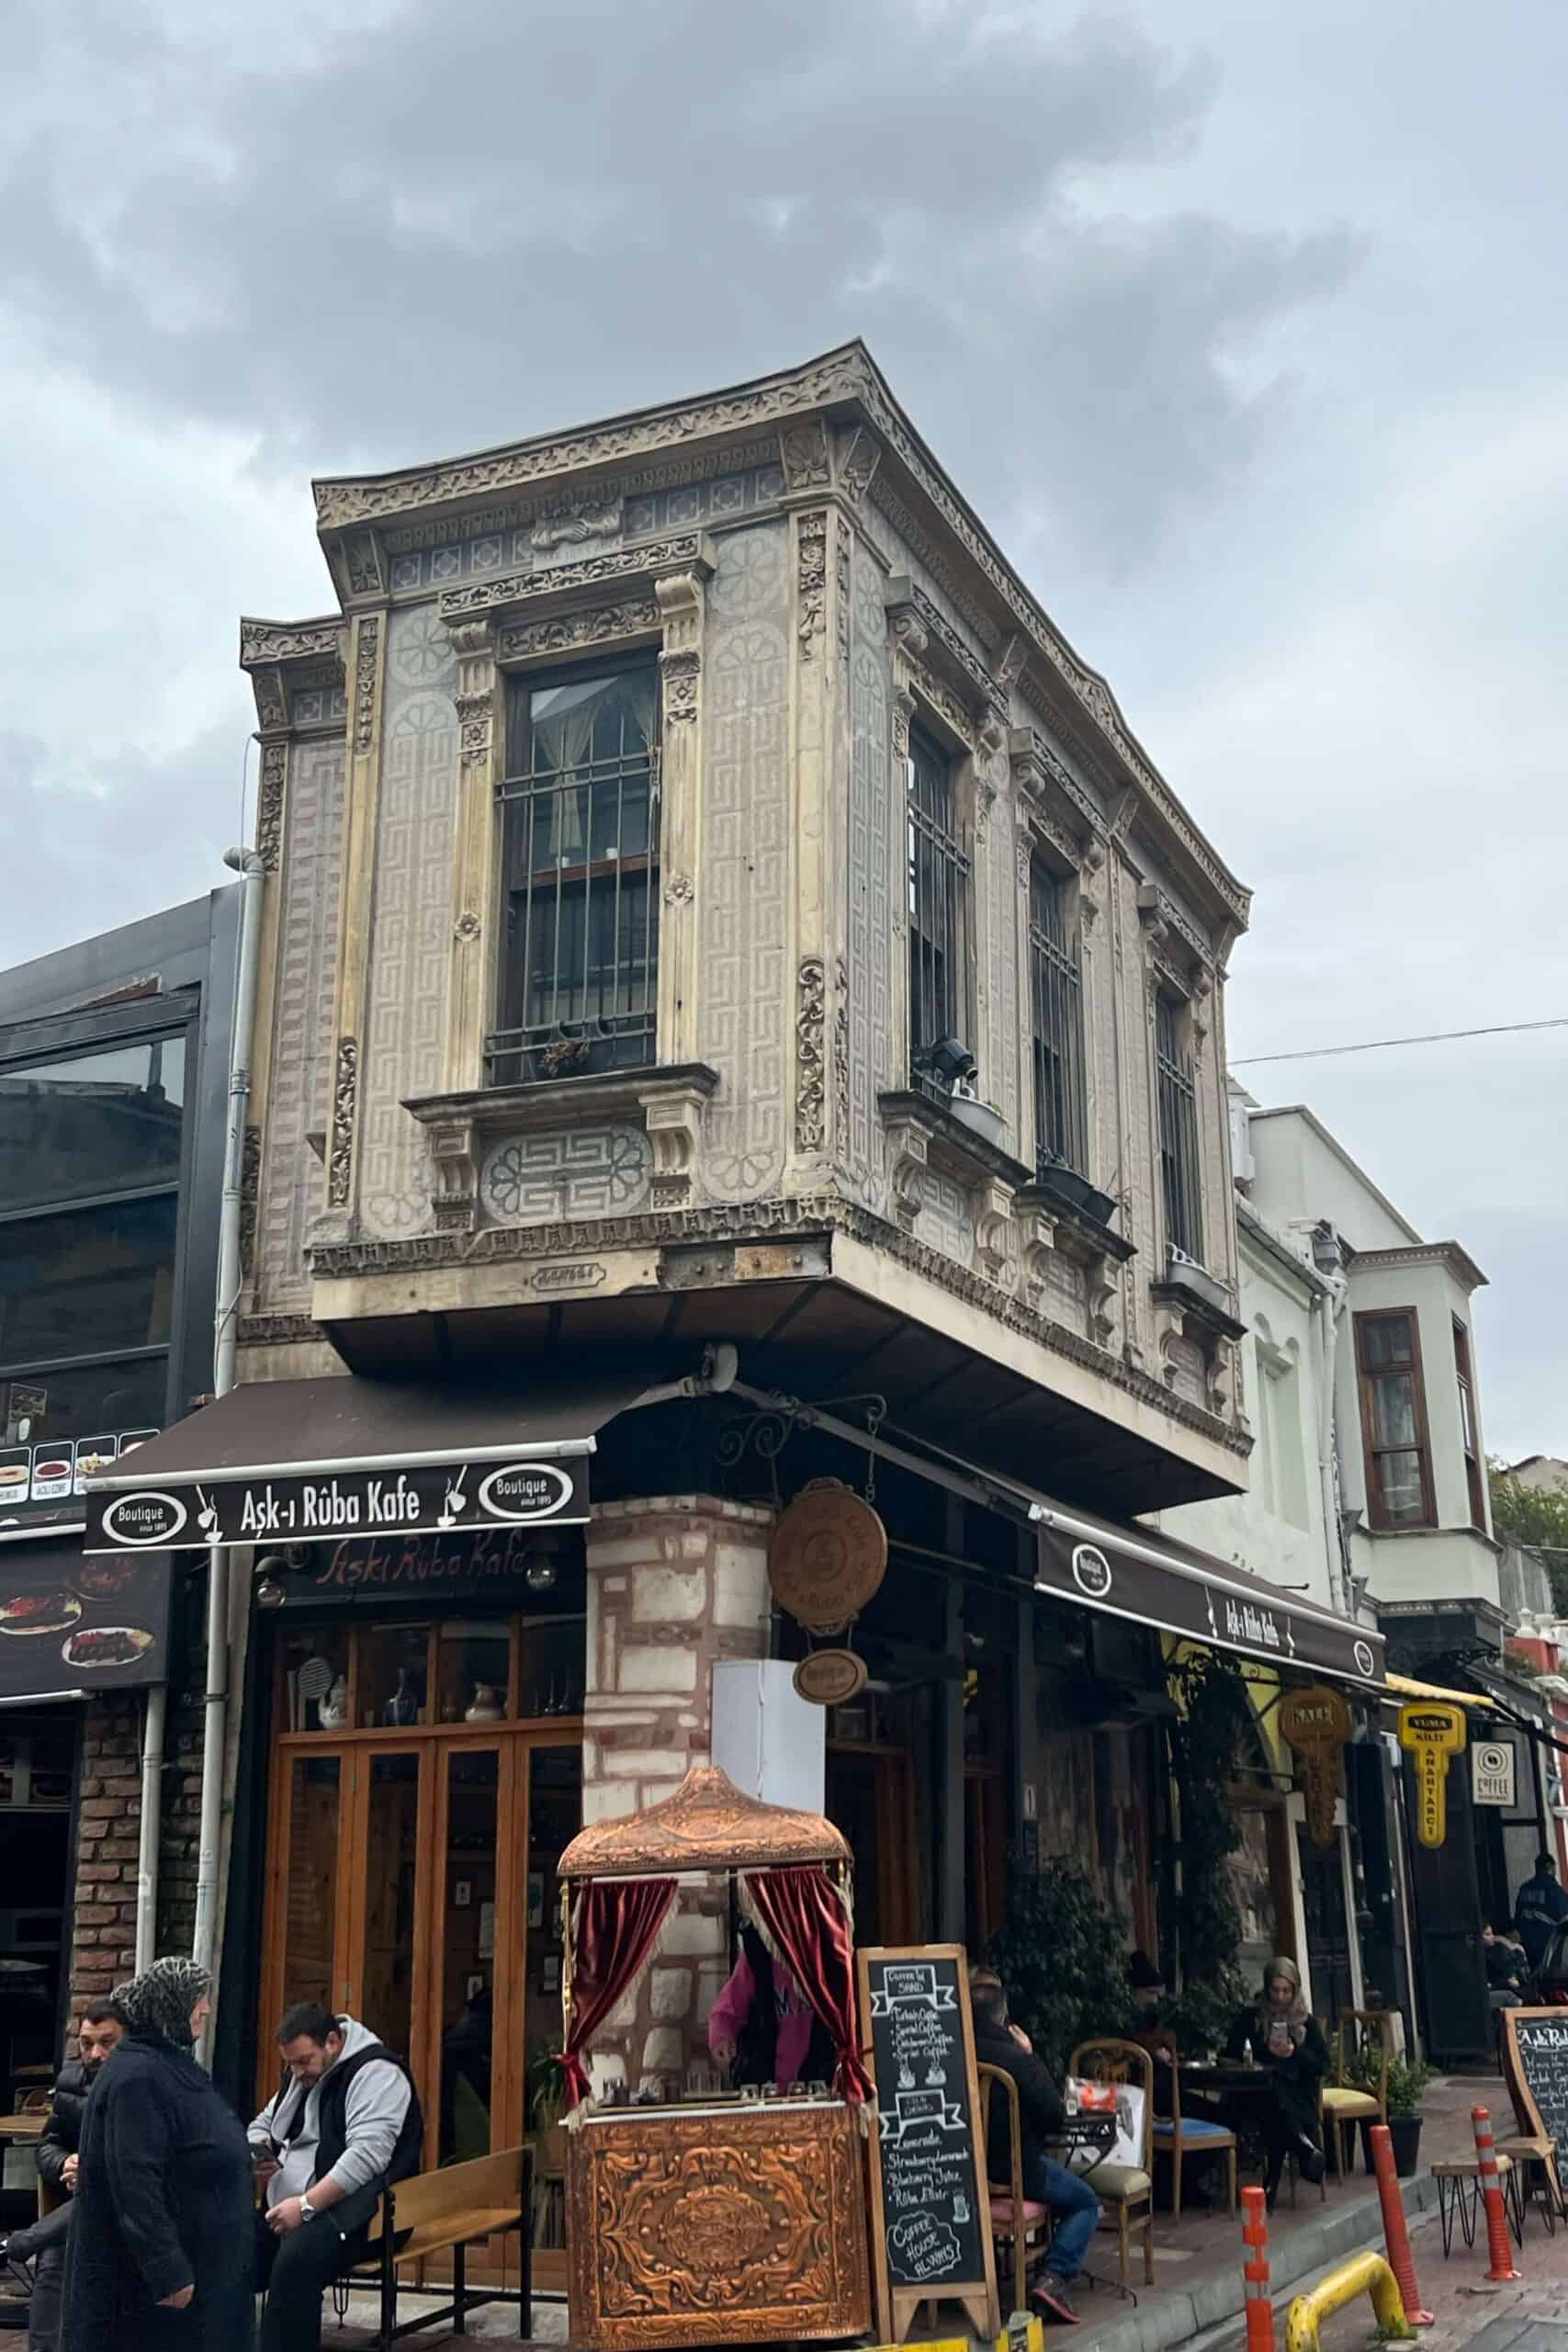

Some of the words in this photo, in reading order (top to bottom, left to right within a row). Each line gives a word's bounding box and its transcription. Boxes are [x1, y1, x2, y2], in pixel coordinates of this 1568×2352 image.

[497, 1477, 547, 1498] Boutique
[303, 1479, 360, 1527] Rûba
[367, 1475, 420, 1522] Kafe
[118, 1505, 164, 1524] Boutique
